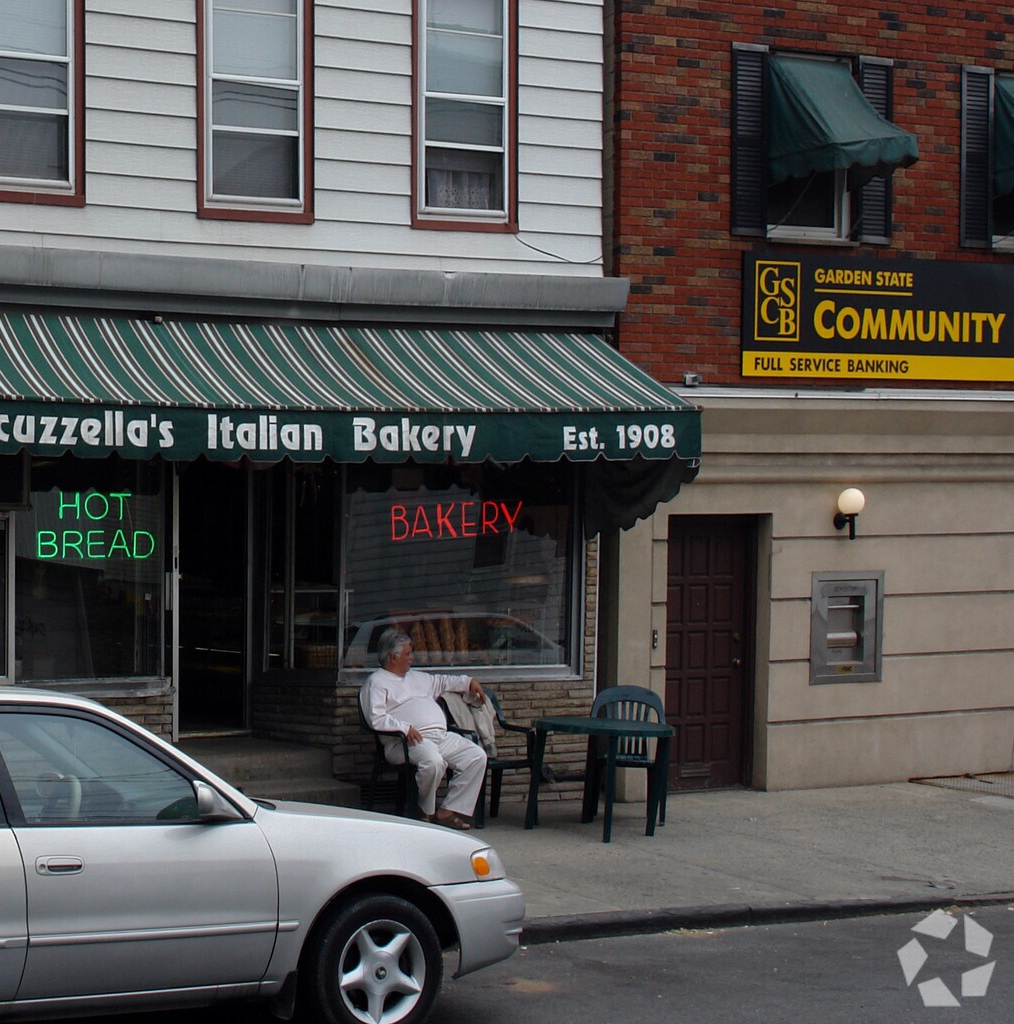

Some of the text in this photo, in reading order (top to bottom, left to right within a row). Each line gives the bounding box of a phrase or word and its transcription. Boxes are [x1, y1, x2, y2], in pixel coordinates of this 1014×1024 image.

[814, 268, 914, 288] GARDEN STATE
[813, 299, 1006, 344] COMMUNITY
[754, 357, 910, 374] FULL SERVICE BANKING
[206, 413, 324, 451] Italian
[352, 417, 477, 457] Bakery
[563, 424, 676, 451] Est. 1908
[57, 490, 132, 521] HOT
[390, 500, 524, 541] BAKERY
[36, 528, 155, 560] BREAD
